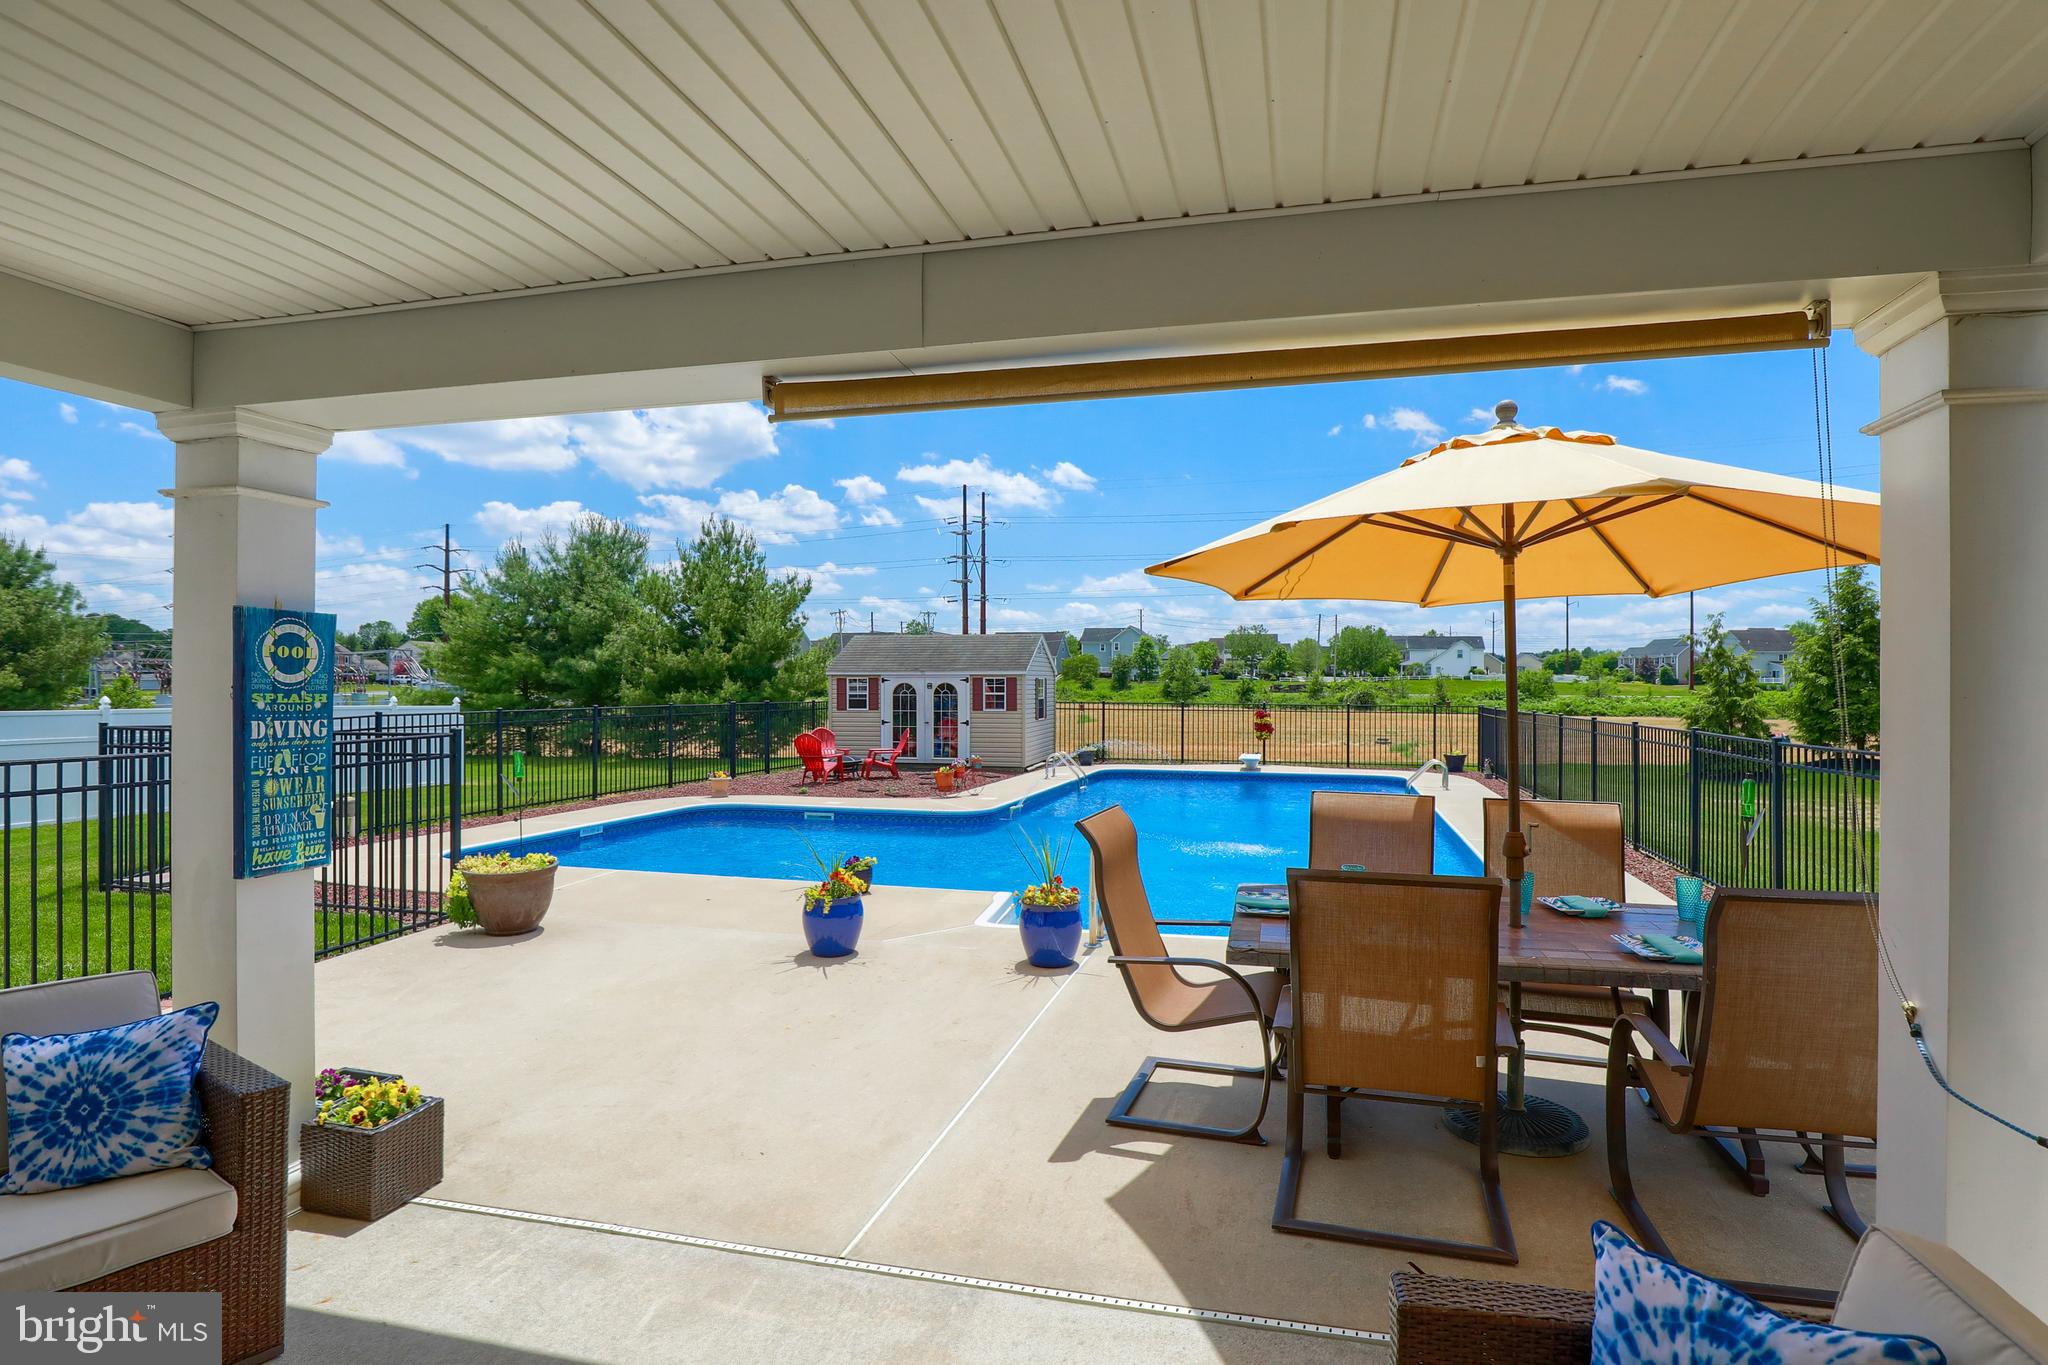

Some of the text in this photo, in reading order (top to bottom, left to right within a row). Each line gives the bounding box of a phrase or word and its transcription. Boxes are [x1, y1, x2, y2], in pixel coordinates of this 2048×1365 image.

[264, 645, 317, 660] POOL
[252, 692, 328, 704] SPLASH
[264, 704, 313, 712] AROUND
[252, 739, 268, 750] only
[291, 738, 310, 748] deep
[250, 752, 327, 769] FLIP FLOP
[266, 765, 310, 777] ZONE
[252, 779, 261, 787] NO
[279, 775, 325, 796] WEAR
[252, 787, 261, 807] PEEING
[262, 793, 326, 811] SUNSCREEN
[252, 814, 261, 824] THE
[263, 808, 310, 826] DRINK
[252, 824, 261, 838] POOL
[263, 820, 314, 837] LEMONADE
[252, 830, 326, 847] NO RUNNING
[252, 840, 326, 866] have fun
